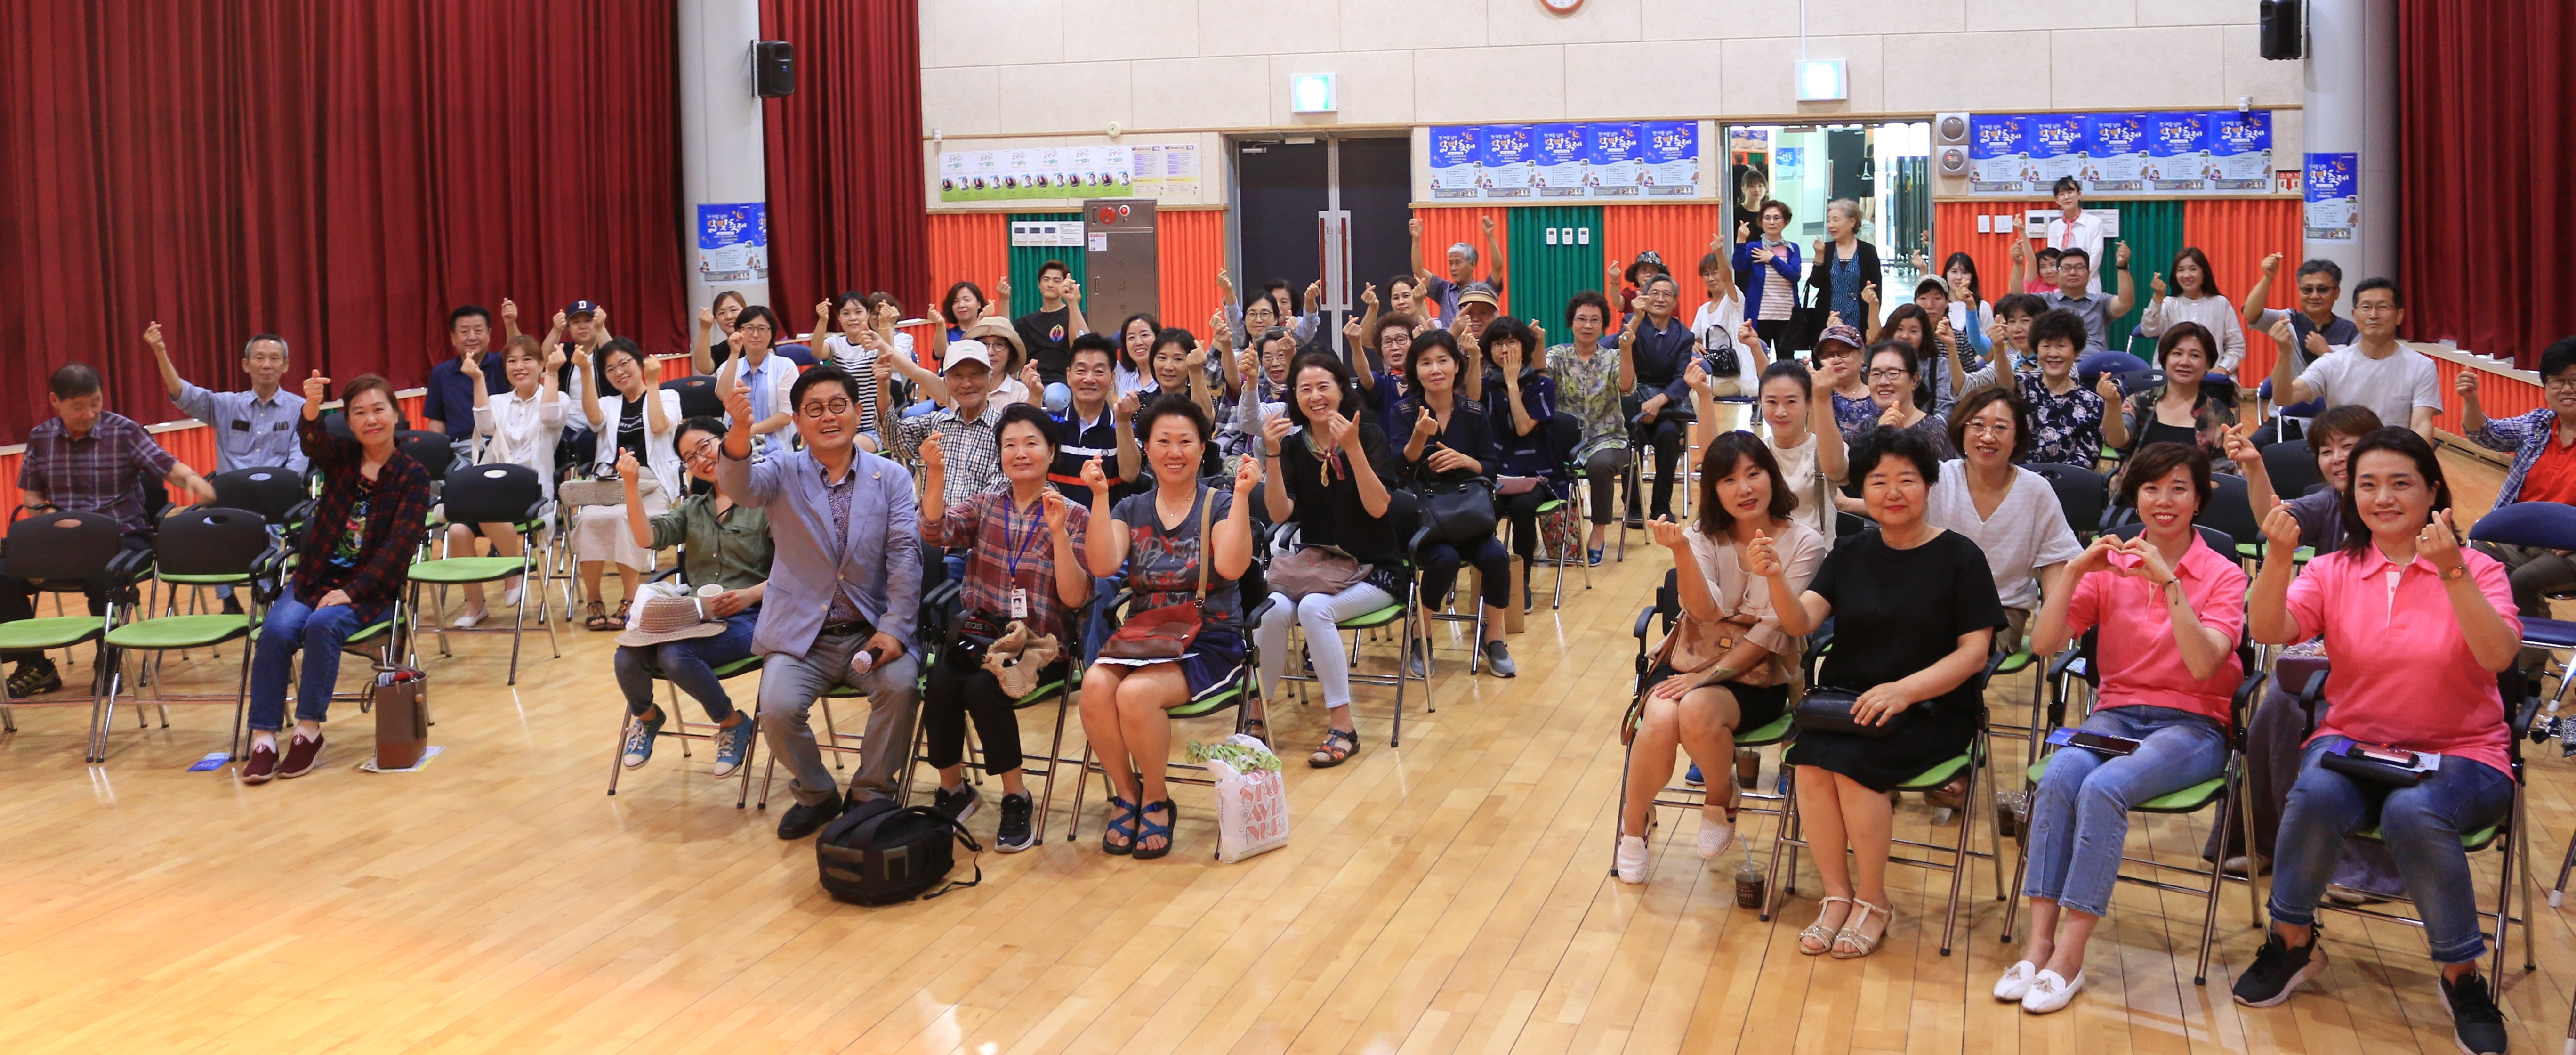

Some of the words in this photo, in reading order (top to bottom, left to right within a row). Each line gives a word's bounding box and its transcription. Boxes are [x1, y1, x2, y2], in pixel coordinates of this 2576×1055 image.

[578, 300, 587, 309] D
[965, 622, 982, 630] EOS
[1246, 816, 1282, 844] NUE
